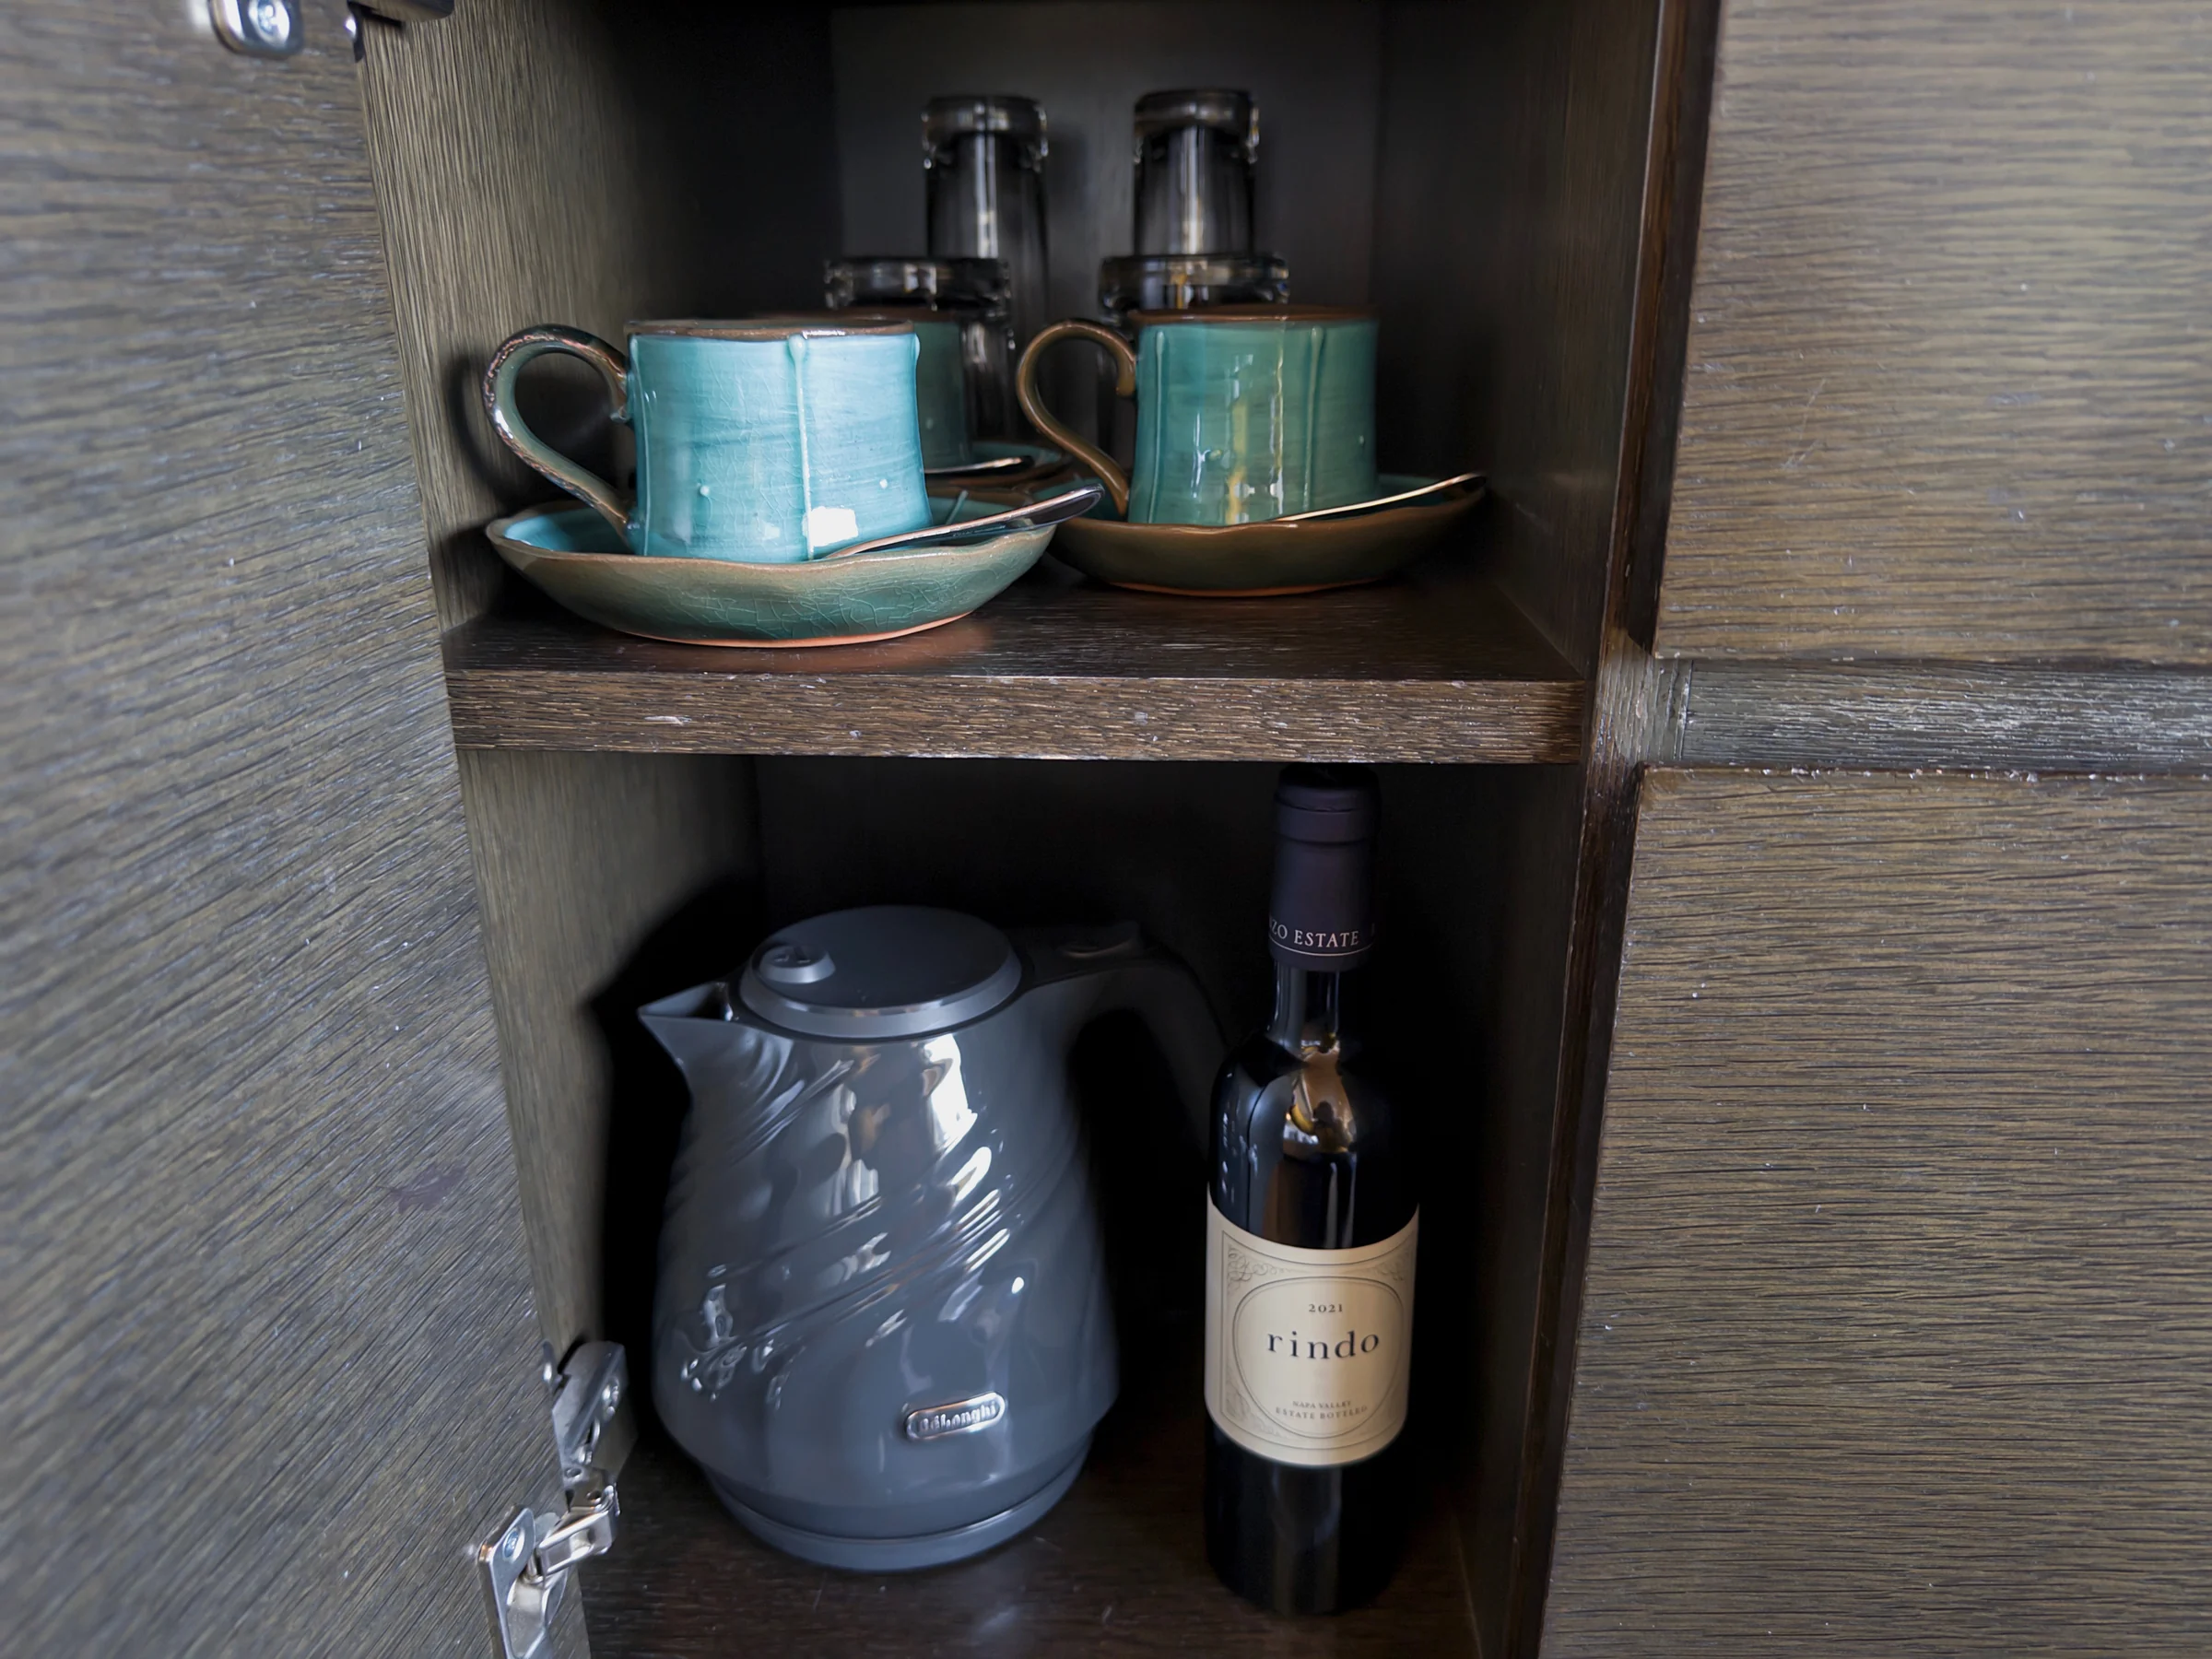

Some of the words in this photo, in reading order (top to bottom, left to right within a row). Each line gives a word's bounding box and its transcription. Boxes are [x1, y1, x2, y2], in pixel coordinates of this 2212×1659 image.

[1269, 915, 1288, 939] ZO
[1293, 929, 1359, 947] ESTATE
[1308, 1303, 1344, 1313] 2021
[1267, 1330, 1380, 1359] rindo
[1292, 1400, 1316, 1410] NAPA
[1319, 1400, 1351, 1409] VALLEY
[1276, 1406, 1315, 1420] ESTATE
[1320, 1406, 1369, 1420] BOTTLED
